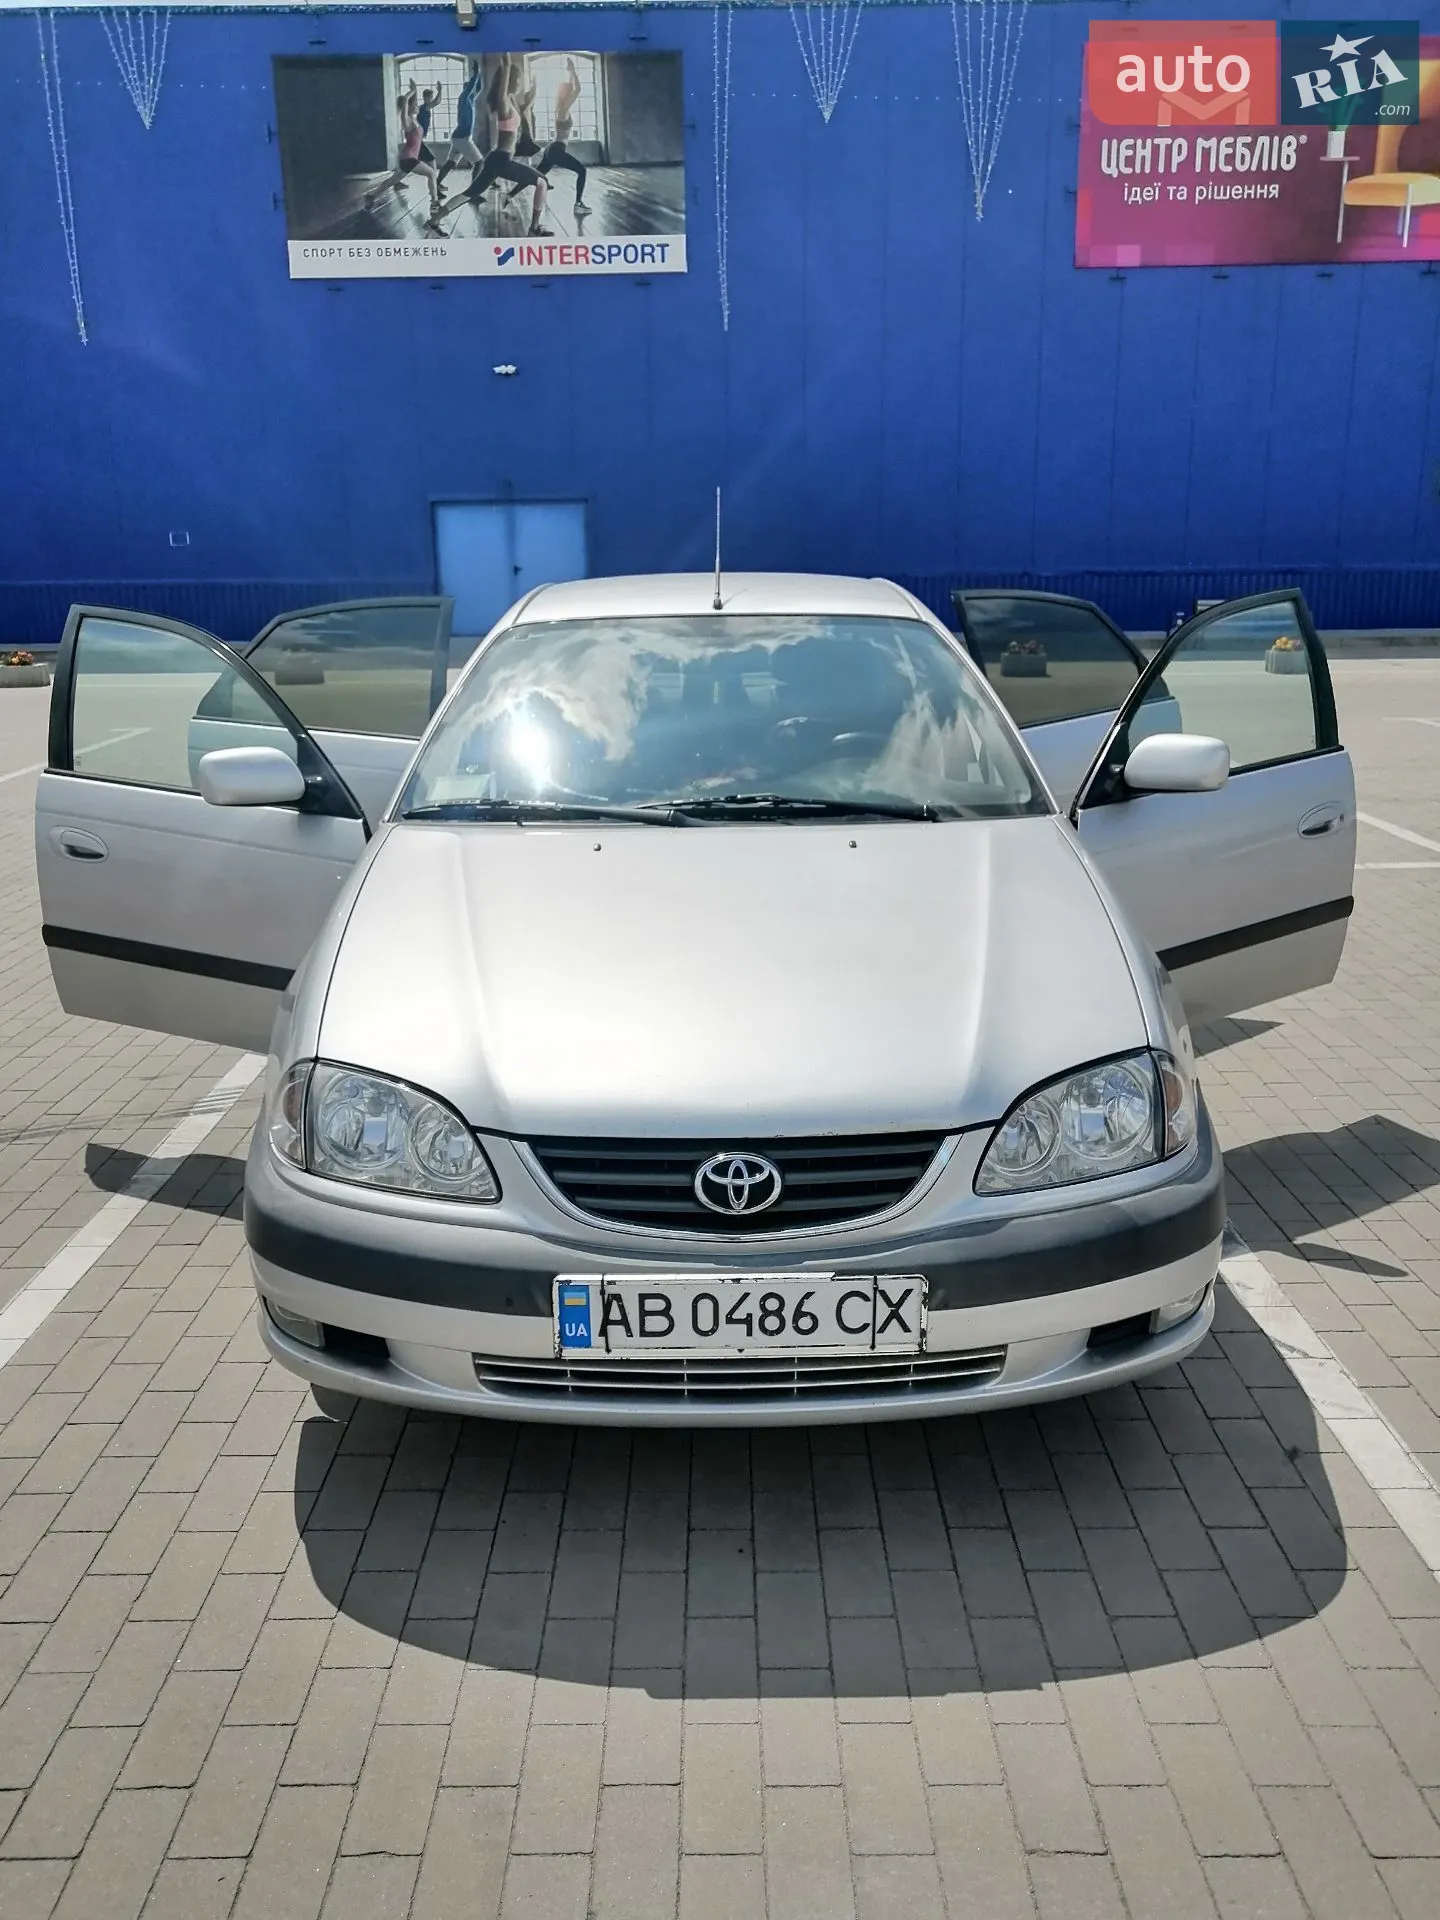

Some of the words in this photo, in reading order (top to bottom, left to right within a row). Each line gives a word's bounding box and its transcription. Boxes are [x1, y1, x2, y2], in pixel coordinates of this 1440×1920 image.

[1100, 138, 1188, 178] ЦЕНТР
[1123, 183, 1160, 205] ідеї
[1167, 185, 1187, 201] та
[1195, 181, 1280, 205] рішення
[303, 248, 343, 258] СПОРТ
[348, 247, 372, 258] БЕЗ
[376, 246, 448, 257] ОБМЕЖЕНЬ
[518, 243, 670, 267] INTERSPORT
[598, 1292, 676, 1339] AB
[690, 1291, 820, 1338] 0486
[834, 1287, 914, 1336] CX
[565, 1323, 588, 1338] UA
